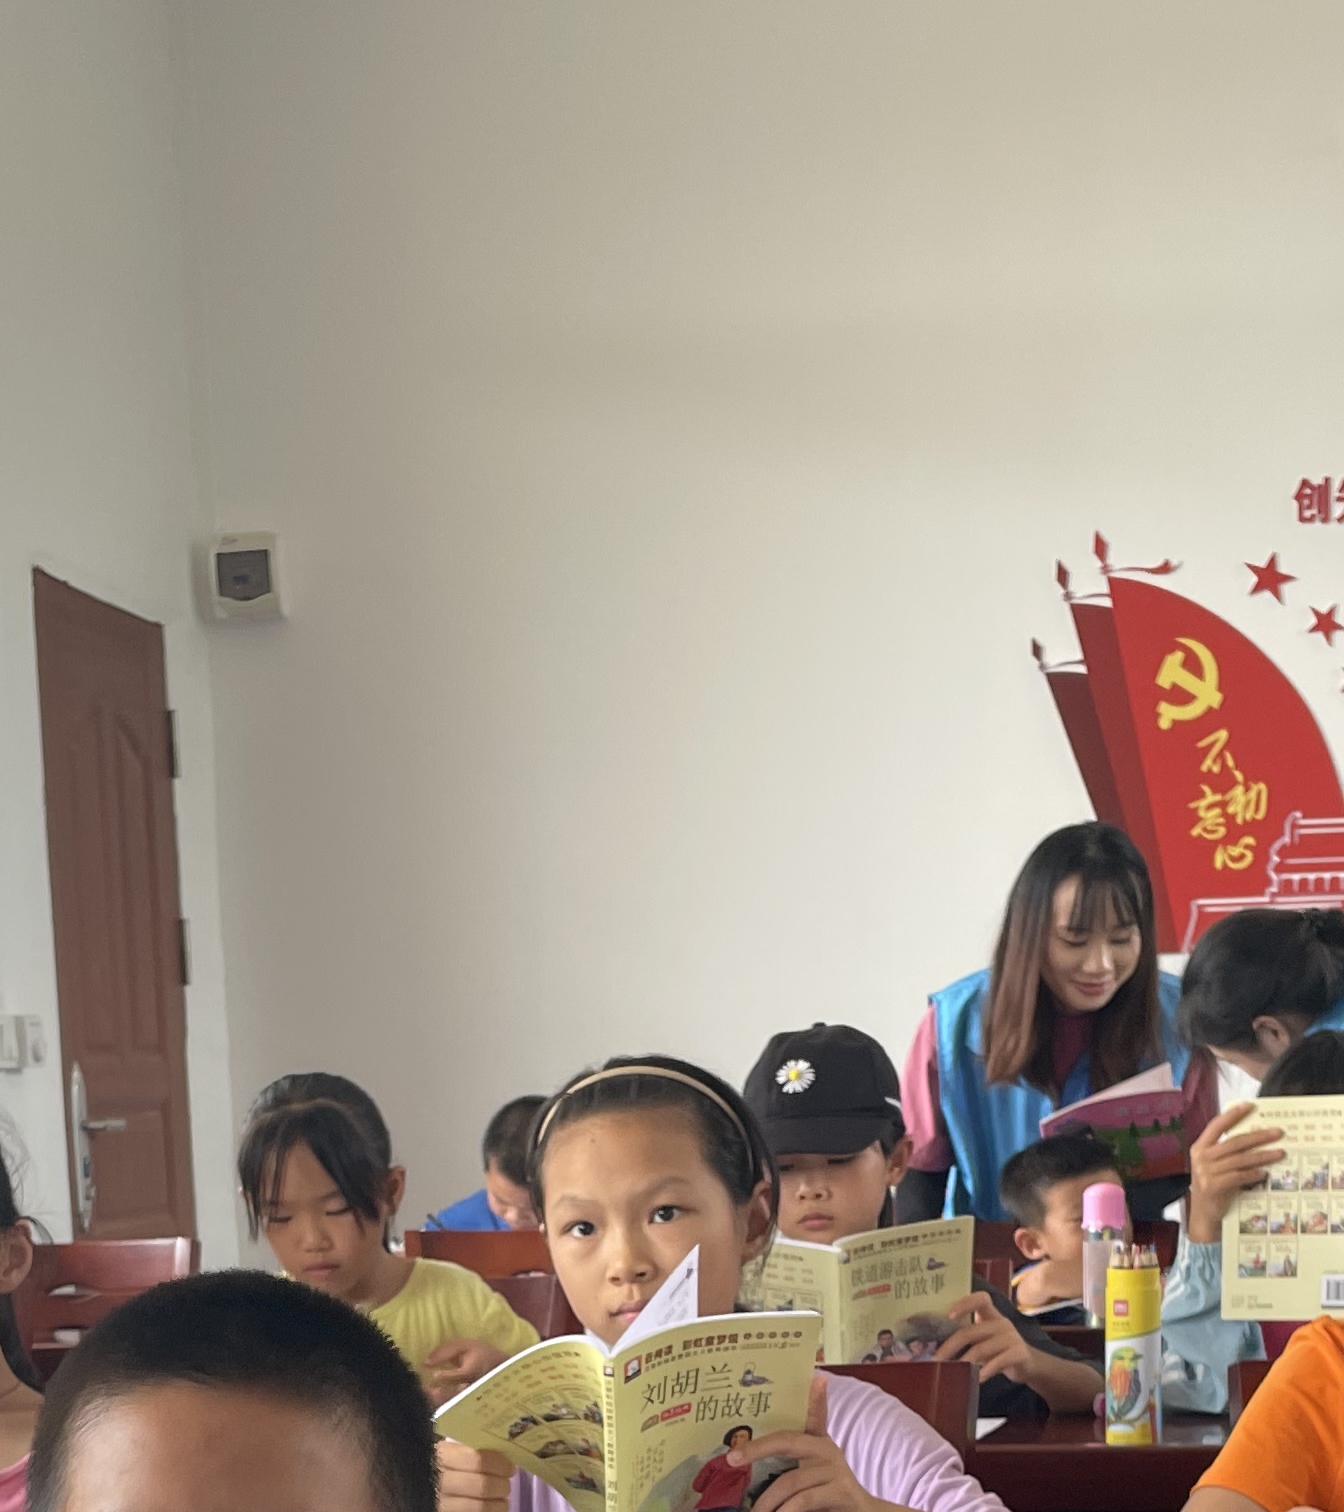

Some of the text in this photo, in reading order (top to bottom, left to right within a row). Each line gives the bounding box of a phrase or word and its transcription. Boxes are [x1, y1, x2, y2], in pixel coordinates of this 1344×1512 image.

[894, 1273, 945, 1300] 的故事
[640, 1363, 733, 1415] 刘胡兰
[695, 1391, 773, 1424] 的故事
